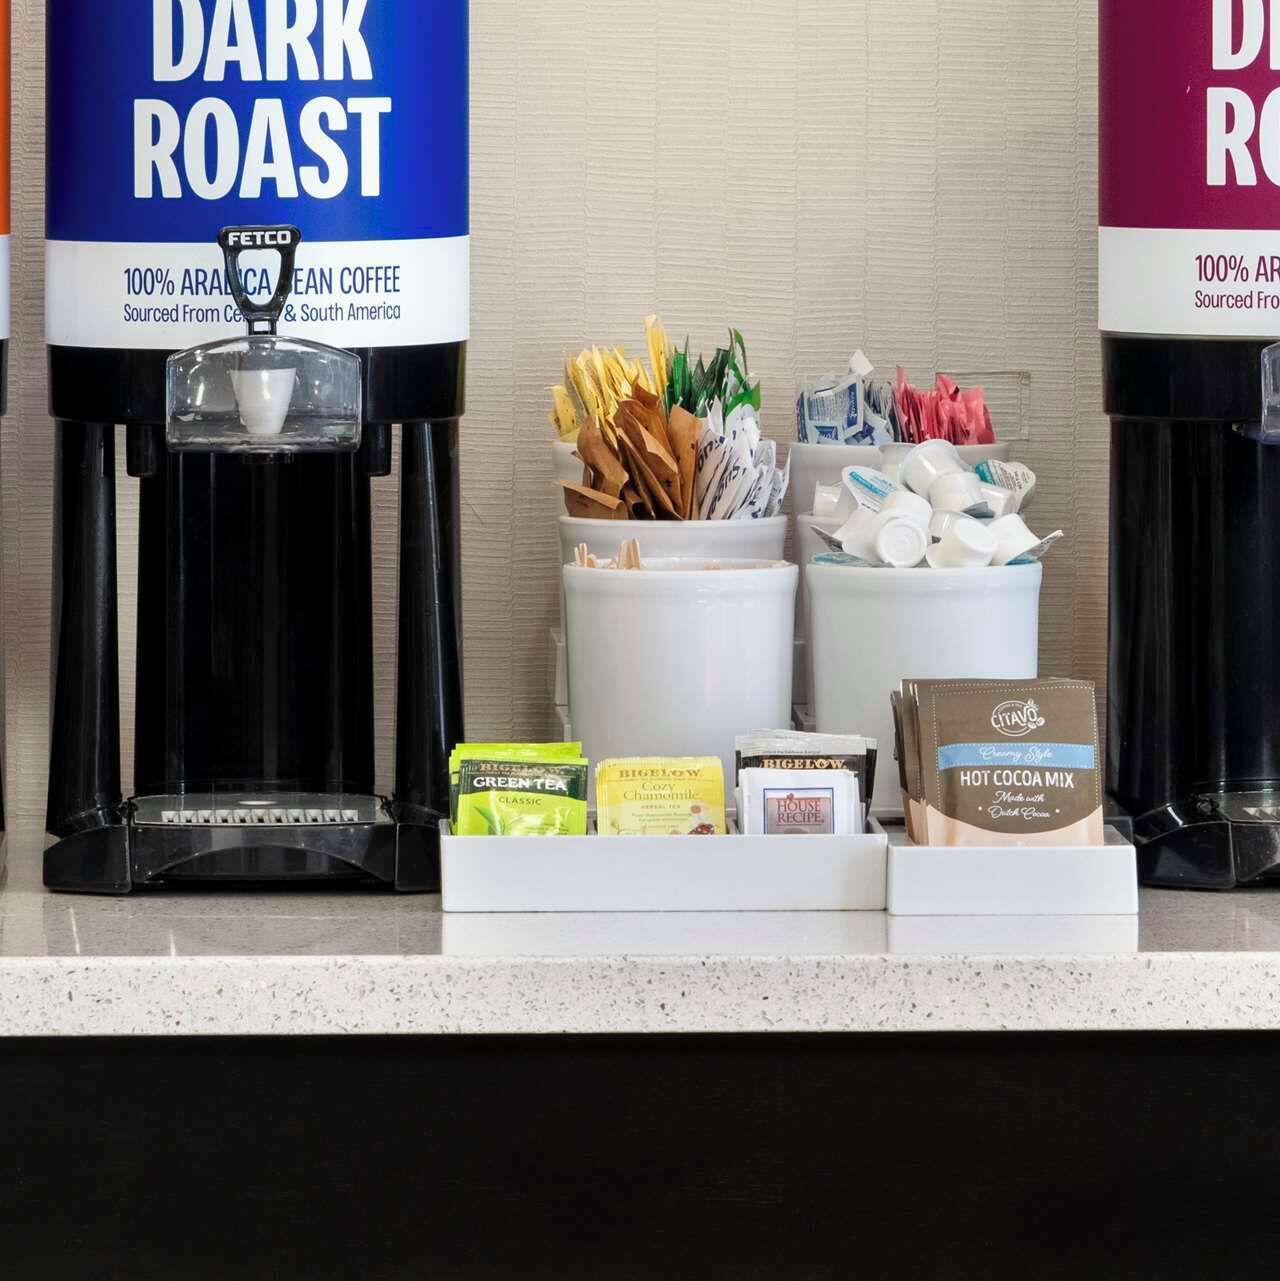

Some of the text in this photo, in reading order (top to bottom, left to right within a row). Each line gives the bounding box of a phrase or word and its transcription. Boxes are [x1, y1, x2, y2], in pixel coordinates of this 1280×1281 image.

[133, 96, 392, 200] ROAST
[228, 230, 292, 246] FETCO
[1195, 254, 1249, 283] 100%
[123, 267, 175, 296] 100%
[293, 267, 333, 296] EAN
[339, 265, 401, 294] COFFEE
[1195, 290, 1253, 309] Sourced
[123, 303, 179, 323] Sourced
[183, 304, 220, 323] From
[284, 303, 297, 323] &
[300, 303, 344, 322] South
[347, 301, 401, 321] America
[991, 705, 1038, 728] CITAVO
[979, 746, 1054, 763] Creamy Style
[762, 758, 844, 769] BIGELOW
[619, 768, 701, 778] BIGELOW
[960, 770, 1074, 788] HOT COCOA MIX
[473, 776, 568, 792] GREEN TEA
[641, 782, 676, 792] Cozy
[498, 796, 542, 806] CLASSIC
[623, 789, 700, 801] Chamomile
[992, 790, 1044, 803] Made with
[776, 798, 822, 812] HOUSE
[988, 805, 1050, 820] Dutch Cocoa
[776, 811, 822, 824] RECIPE
